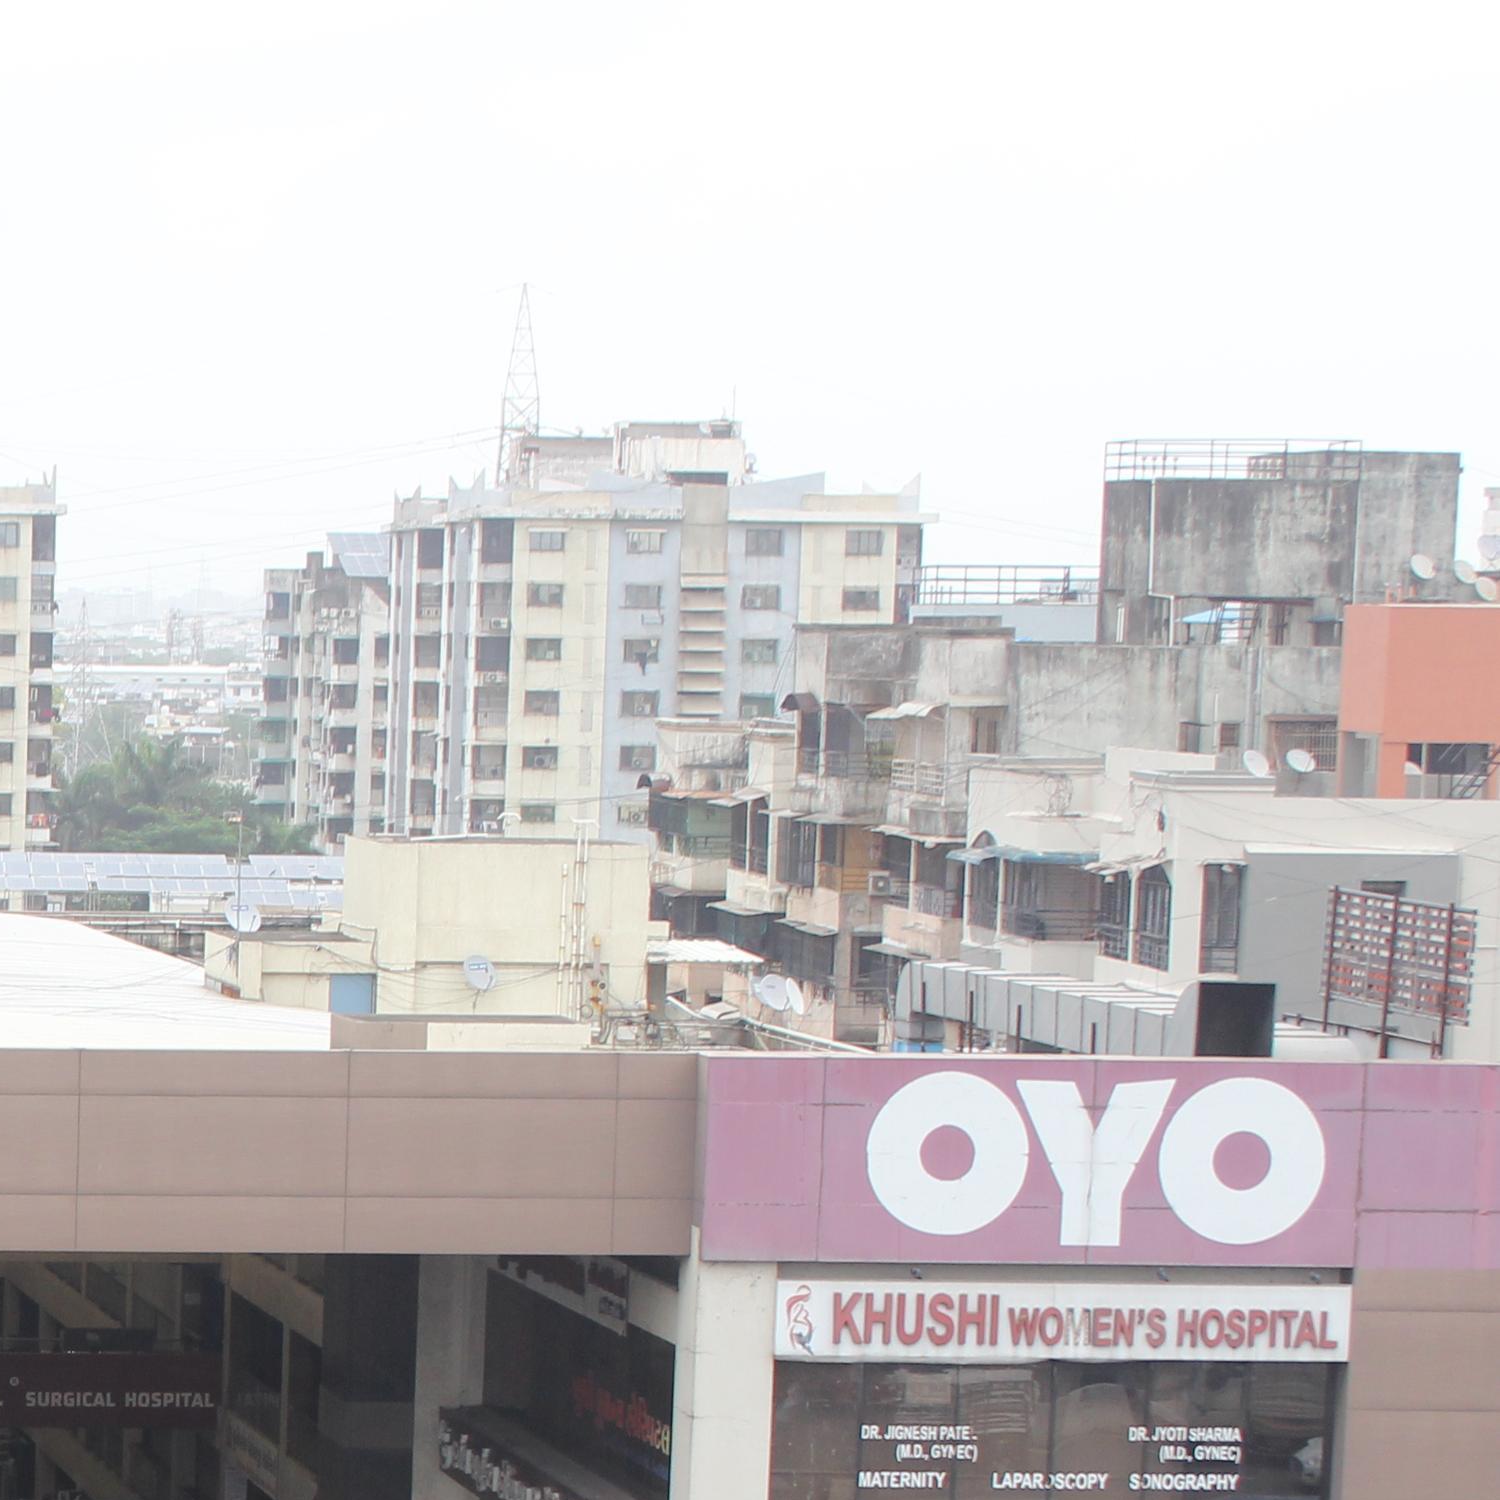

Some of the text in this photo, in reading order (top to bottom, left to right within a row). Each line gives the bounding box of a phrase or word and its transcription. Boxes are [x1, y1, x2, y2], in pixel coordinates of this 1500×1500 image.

[866, 1070, 1325, 1247] OYO
[833, 1291, 1338, 1350] KHUSHI WOMEN'S HOSPITAL
[25, 1391, 116, 1408] SURGICAL
[124, 1391, 214, 1408] HOSPITAL
[860, 1425, 977, 1441] DR. JIGNESH PATE
[1128, 1427, 1242, 1442] DR. JYOTI SHARMA
[1195, 1445, 1241, 1462] GYNEC)
[858, 1471, 946, 1488] MATERNITY
[1129, 1473, 1240, 1490] SONOGRAPHY
